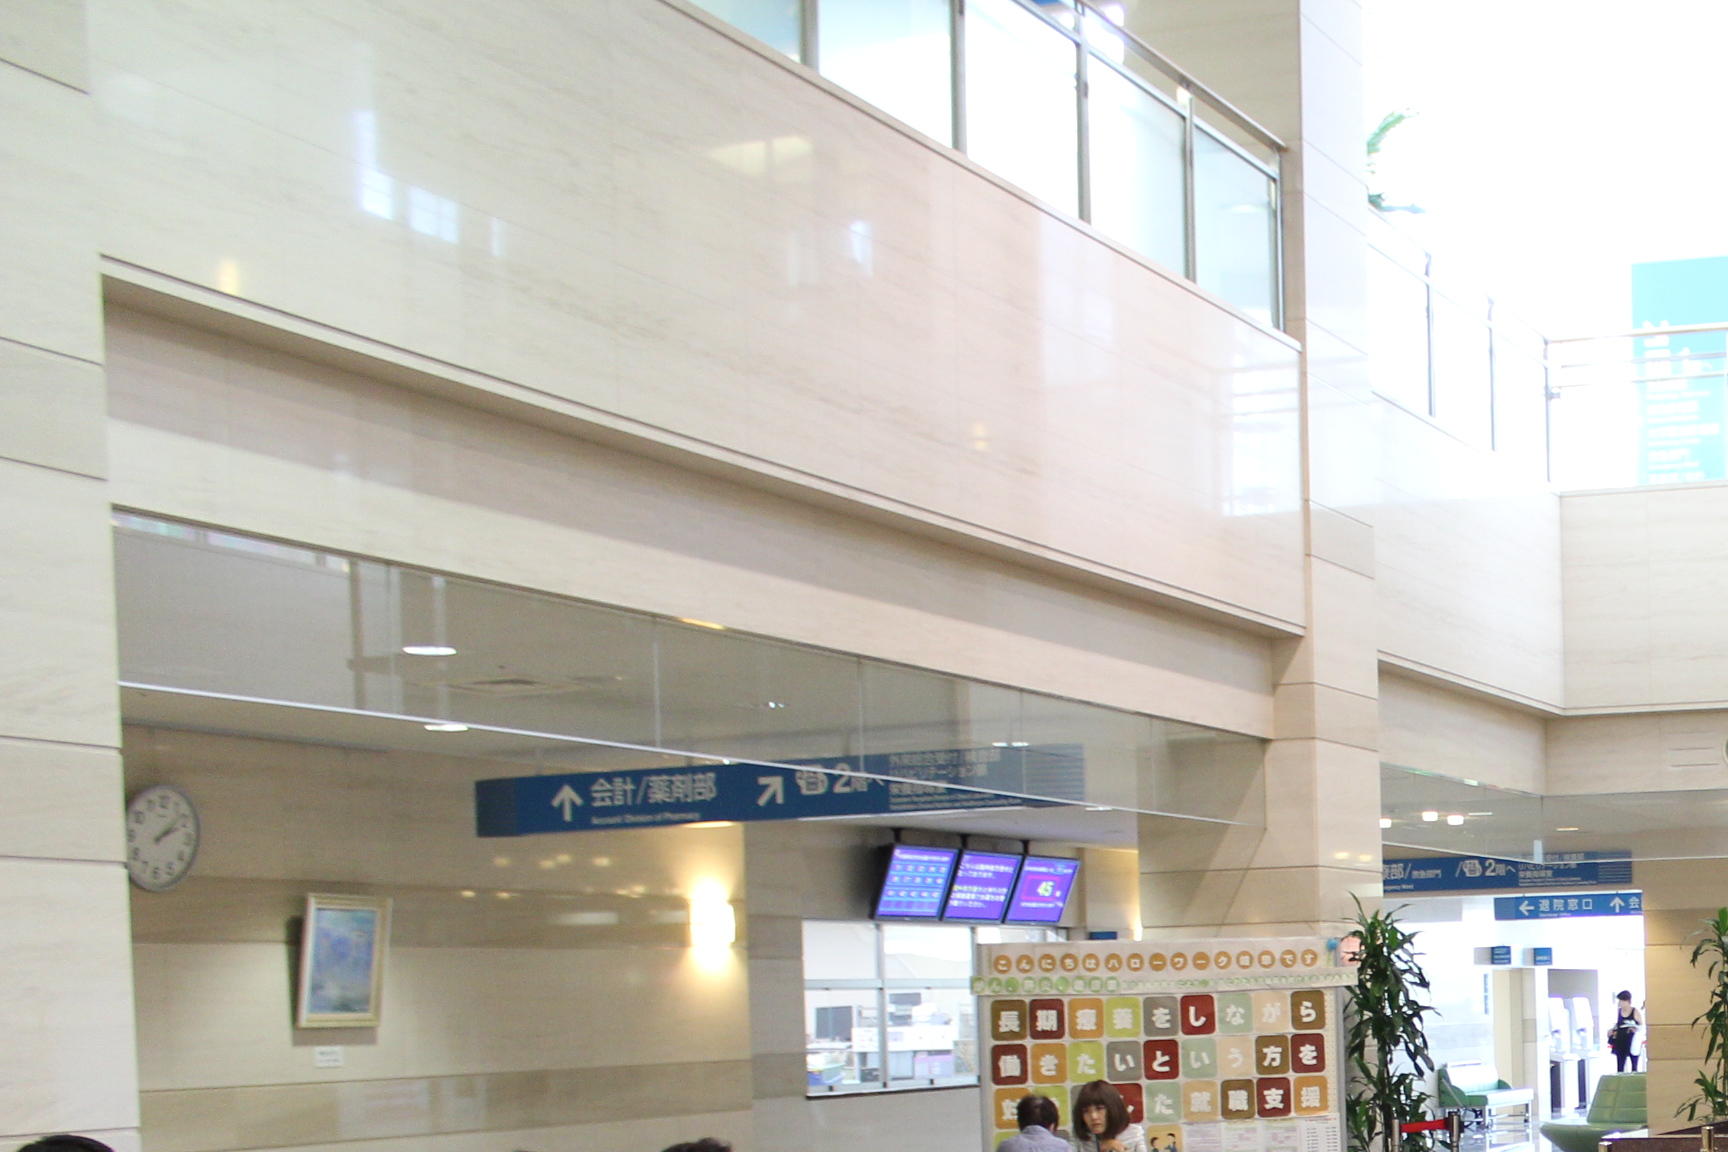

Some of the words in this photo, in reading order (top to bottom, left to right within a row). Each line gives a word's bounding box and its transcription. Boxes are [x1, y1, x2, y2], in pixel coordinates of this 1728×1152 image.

[590, 772, 717, 808] 会計/薬剤部
[998, 1044, 1318, 1077] 働きたいという方を
